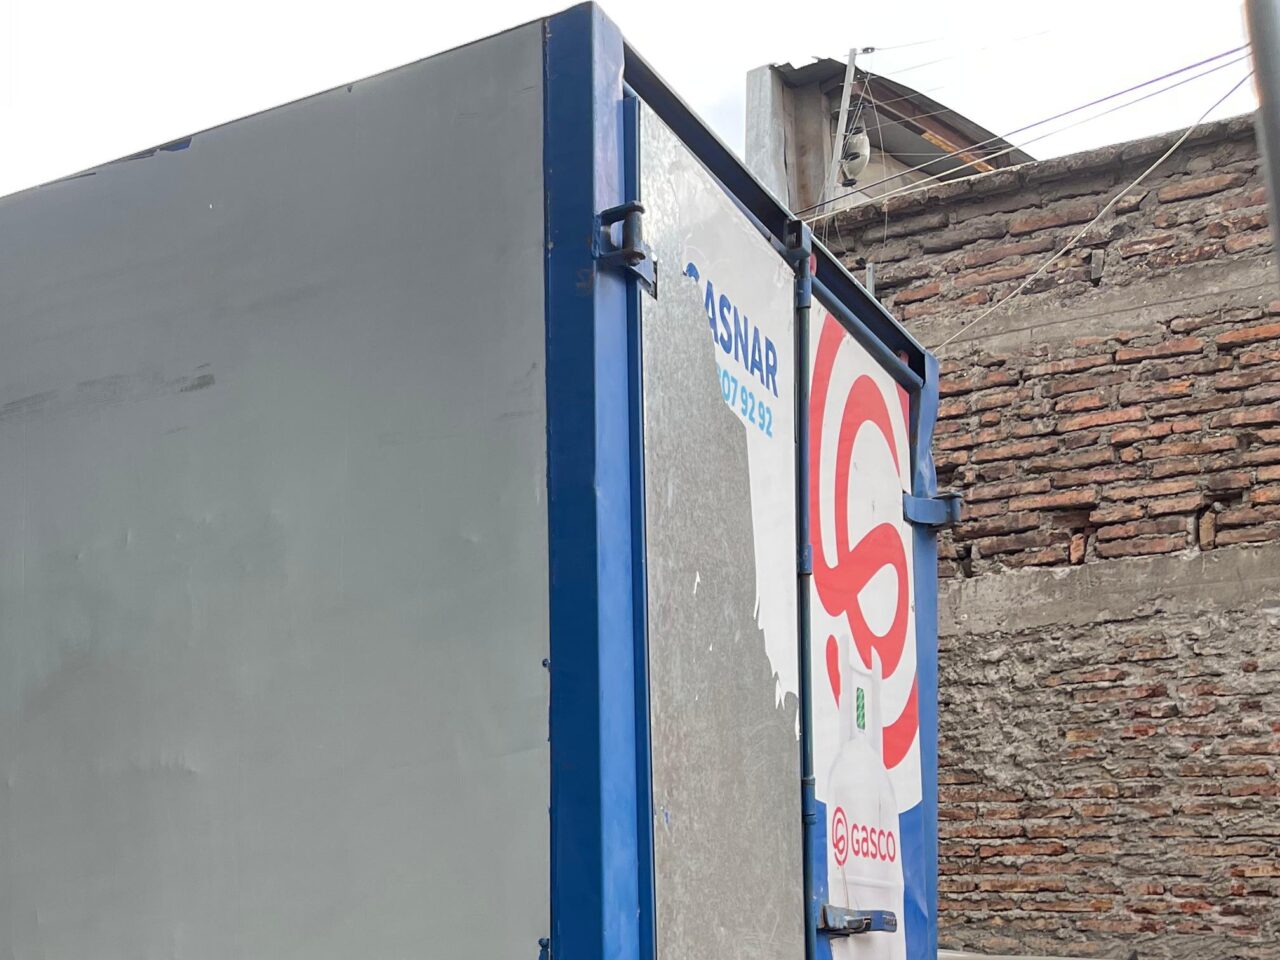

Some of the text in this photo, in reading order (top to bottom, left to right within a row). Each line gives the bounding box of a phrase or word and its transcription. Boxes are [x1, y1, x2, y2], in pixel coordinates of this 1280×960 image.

[684, 262, 778, 398] ASNAR
[741, 385, 756, 424] 92
[758, 401, 773, 438] 92
[851, 823, 896, 863] Gasco
